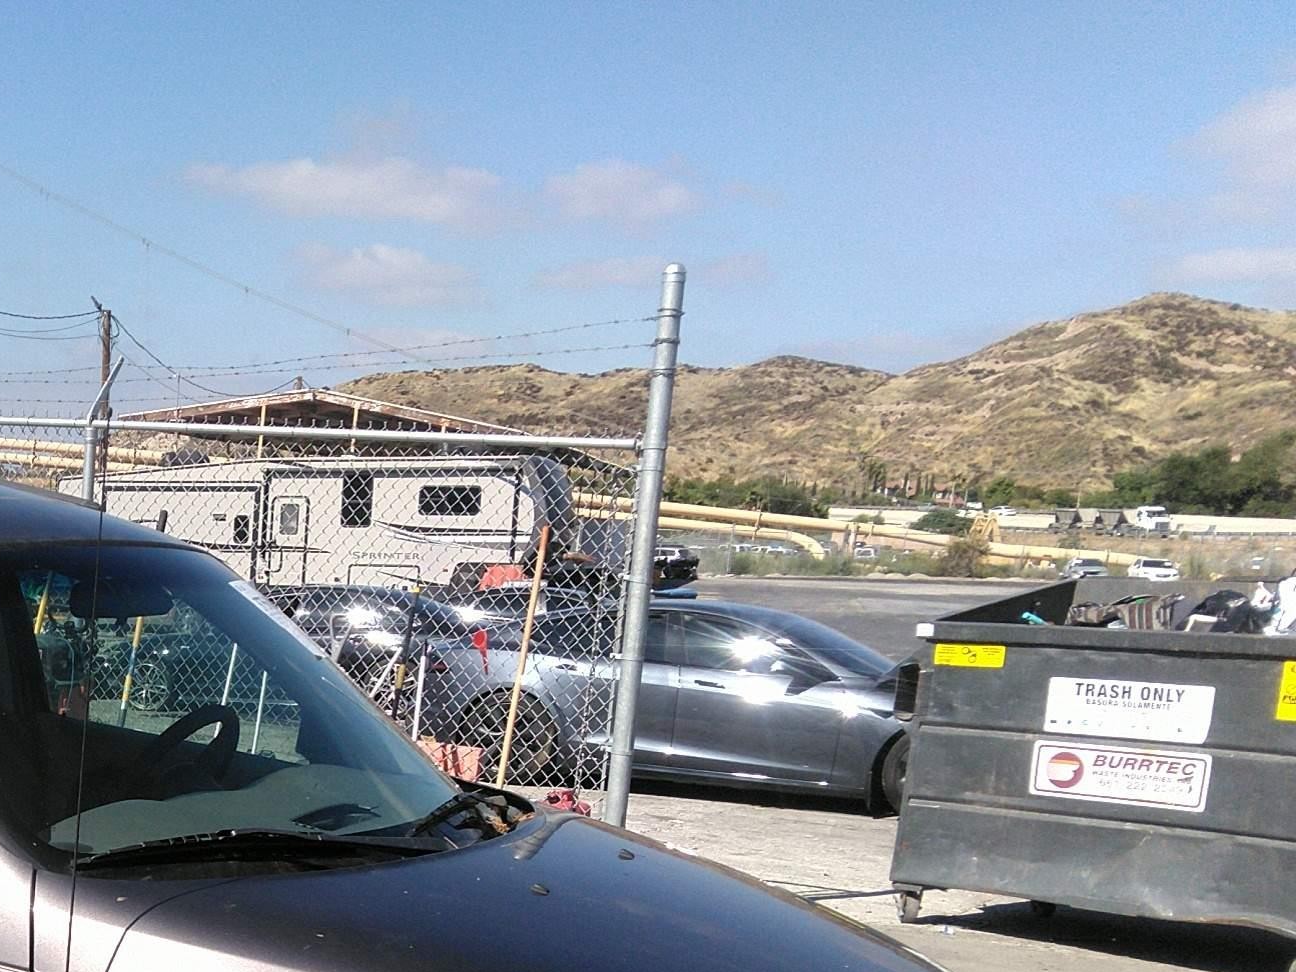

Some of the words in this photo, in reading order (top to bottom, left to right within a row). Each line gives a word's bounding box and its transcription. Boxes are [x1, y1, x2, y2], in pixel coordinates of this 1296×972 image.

[352, 551, 420, 560] SPRINTER
[1075, 682, 1132, 700] TRASH
[1140, 686, 1186, 703] ONLY
[1092, 754, 1197, 776] BURRTEC
